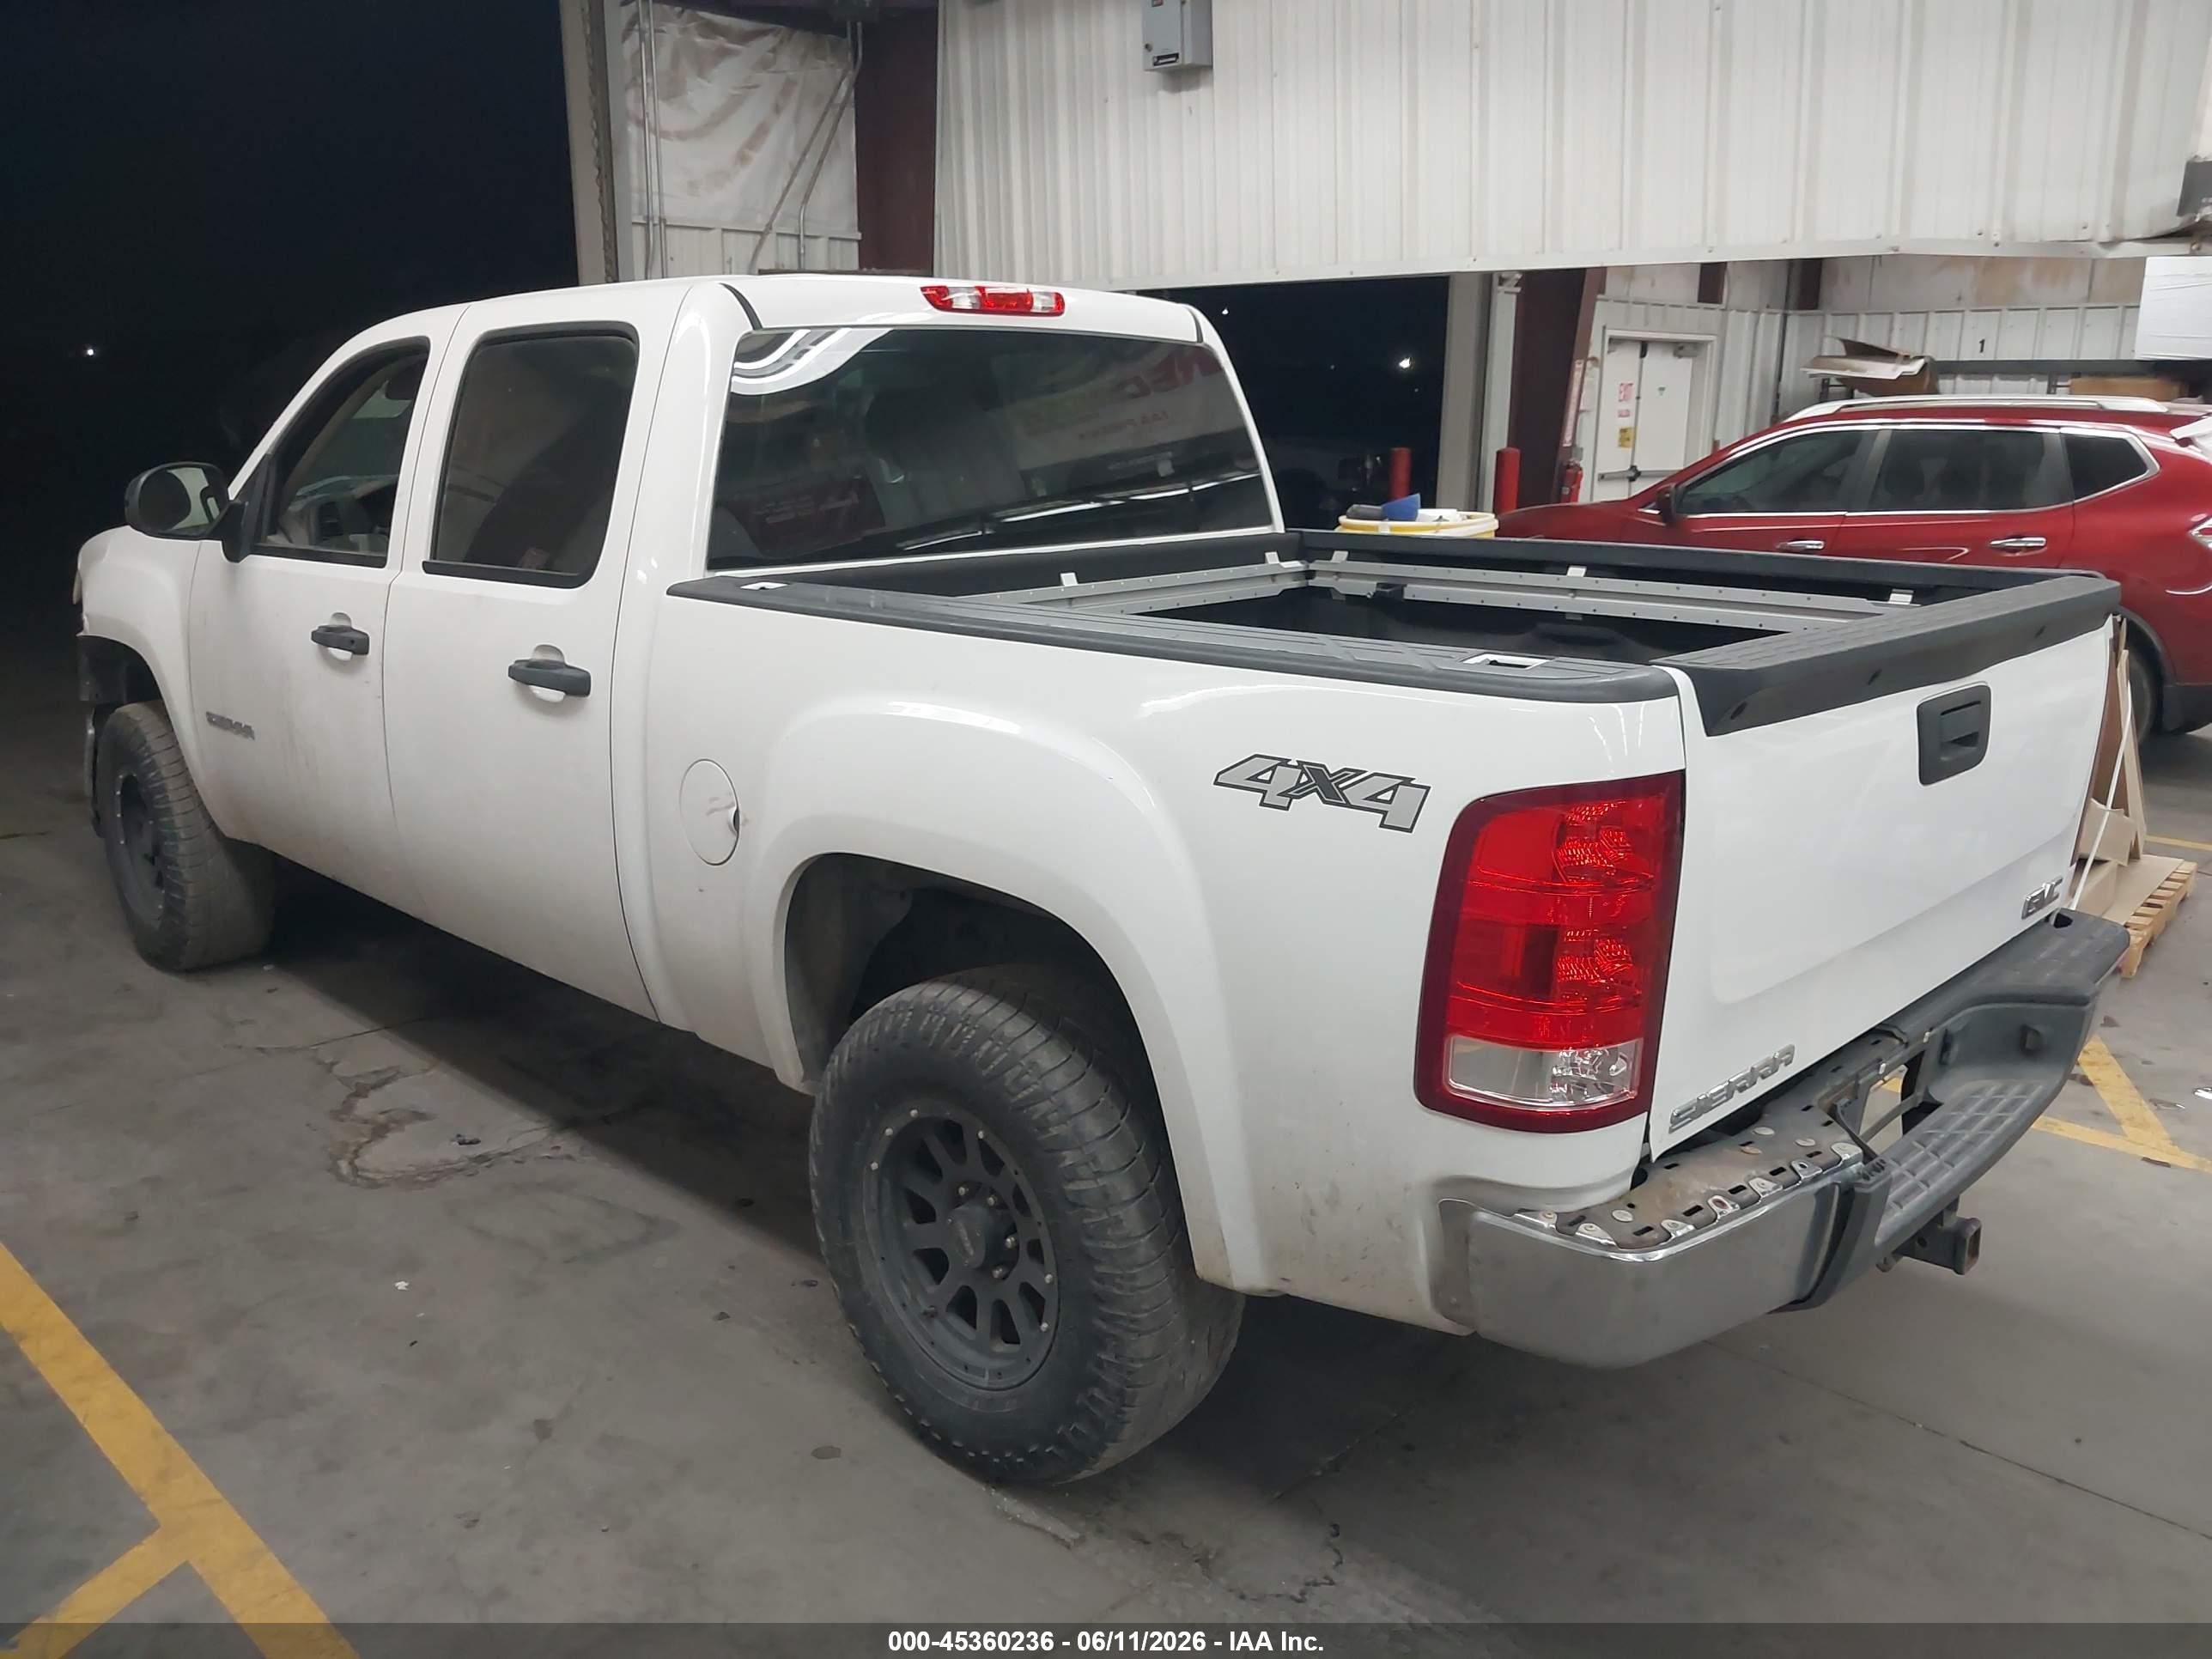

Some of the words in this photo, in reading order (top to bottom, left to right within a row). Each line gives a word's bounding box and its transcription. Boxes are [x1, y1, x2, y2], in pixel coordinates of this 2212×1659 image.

[1978, 338, 1985, 354] 1
[2021, 876, 2063, 920] GMC
[1668, 1043, 1796, 1133] SIERRA
